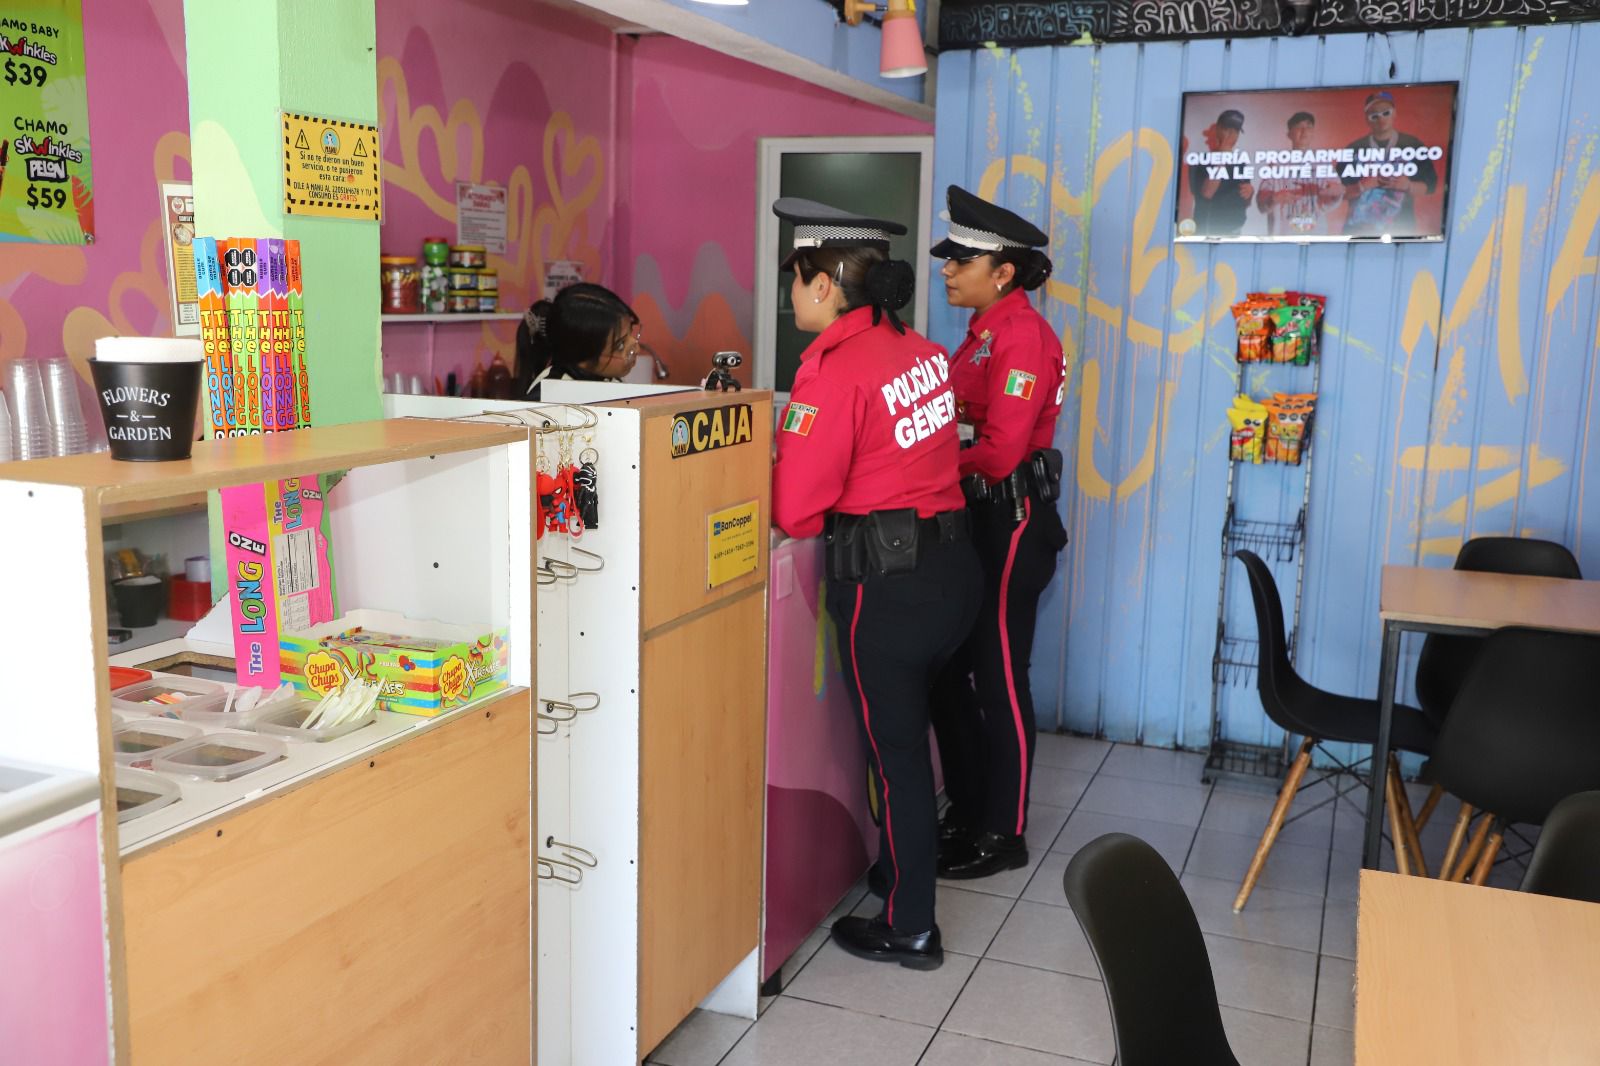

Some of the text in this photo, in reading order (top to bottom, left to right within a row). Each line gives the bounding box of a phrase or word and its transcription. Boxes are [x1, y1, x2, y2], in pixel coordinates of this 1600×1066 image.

[1, 18, 59, 38] AMO BABY
[4, 57, 47, 87] $39
[14, 116, 68, 135] CHAMO
[323, 155, 341, 163] dieron
[351, 158, 364, 167] buen
[1186, 146, 1443, 165] QUERÍA PROBARME UN POCO
[339, 166, 363, 175] pusieron
[1206, 162, 1418, 180] YA LE QUITÉ EL ANTOJO
[293, 181, 304, 190] DILE
[308, 190, 331, 200] CONSUMO
[27, 183, 67, 210] $59
[102, 386, 171, 407] FLOWERS
[207, 355, 223, 426] LONG
[220, 355, 236, 426] LONG
[234, 354, 246, 425] LONG
[247, 354, 260, 426] LONG
[261, 355, 274, 426] LONG
[299, 354, 310, 422] LONG
[881, 357, 940, 416] POLICÍA
[130, 410, 140, 422] &
[895, 386, 956, 449] GÉNER
[109, 426, 172, 441] GARDEN
[692, 405, 752, 451] CAJA
[721, 512, 752, 531] BanCoppel
[237, 560, 266, 633] LONG
[308, 662, 336, 676] Chupa
[442, 662, 462, 683] Chupa
[311, 672, 339, 690] Chups
[443, 672, 463, 694] Chups
